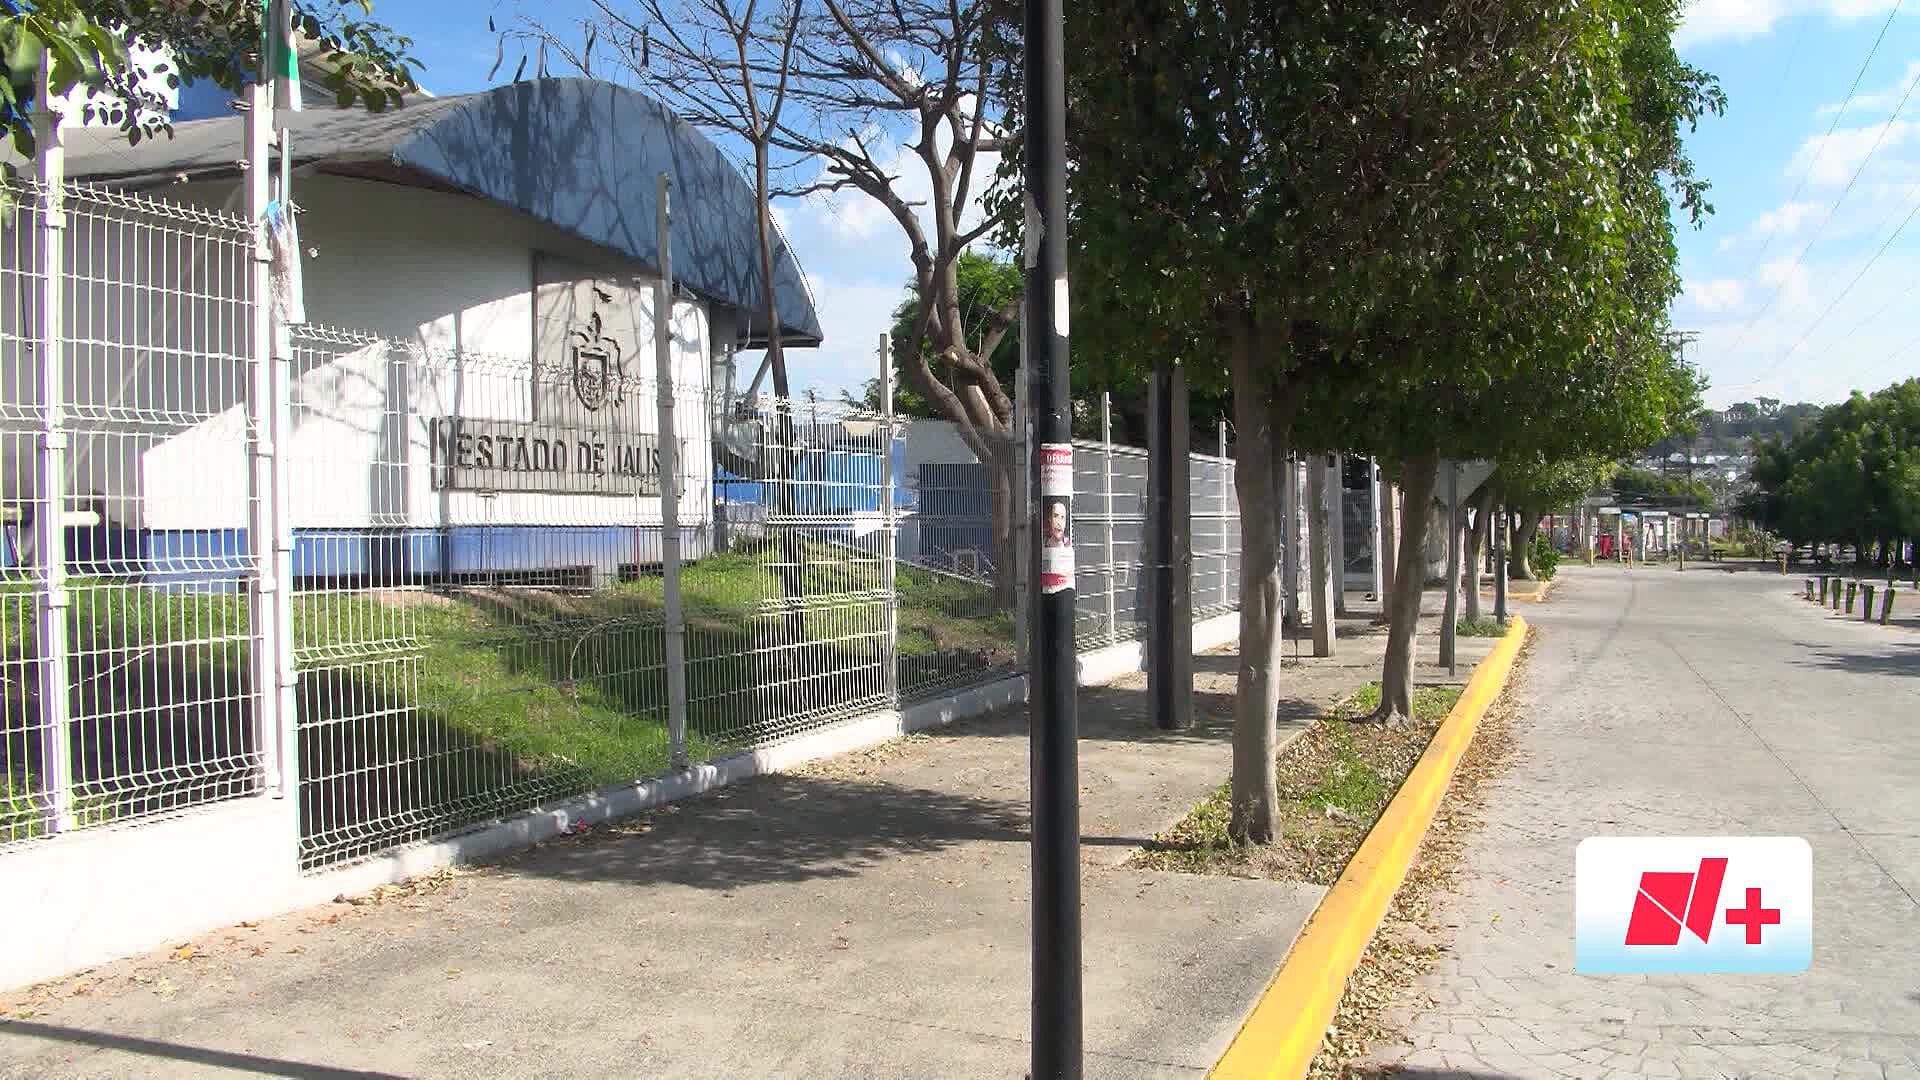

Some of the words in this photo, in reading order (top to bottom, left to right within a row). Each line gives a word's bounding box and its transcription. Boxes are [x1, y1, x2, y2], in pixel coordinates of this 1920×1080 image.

[457, 433, 567, 472] ESTADO
[578, 440, 605, 474] DE
[612, 446, 680, 477] JALIS
